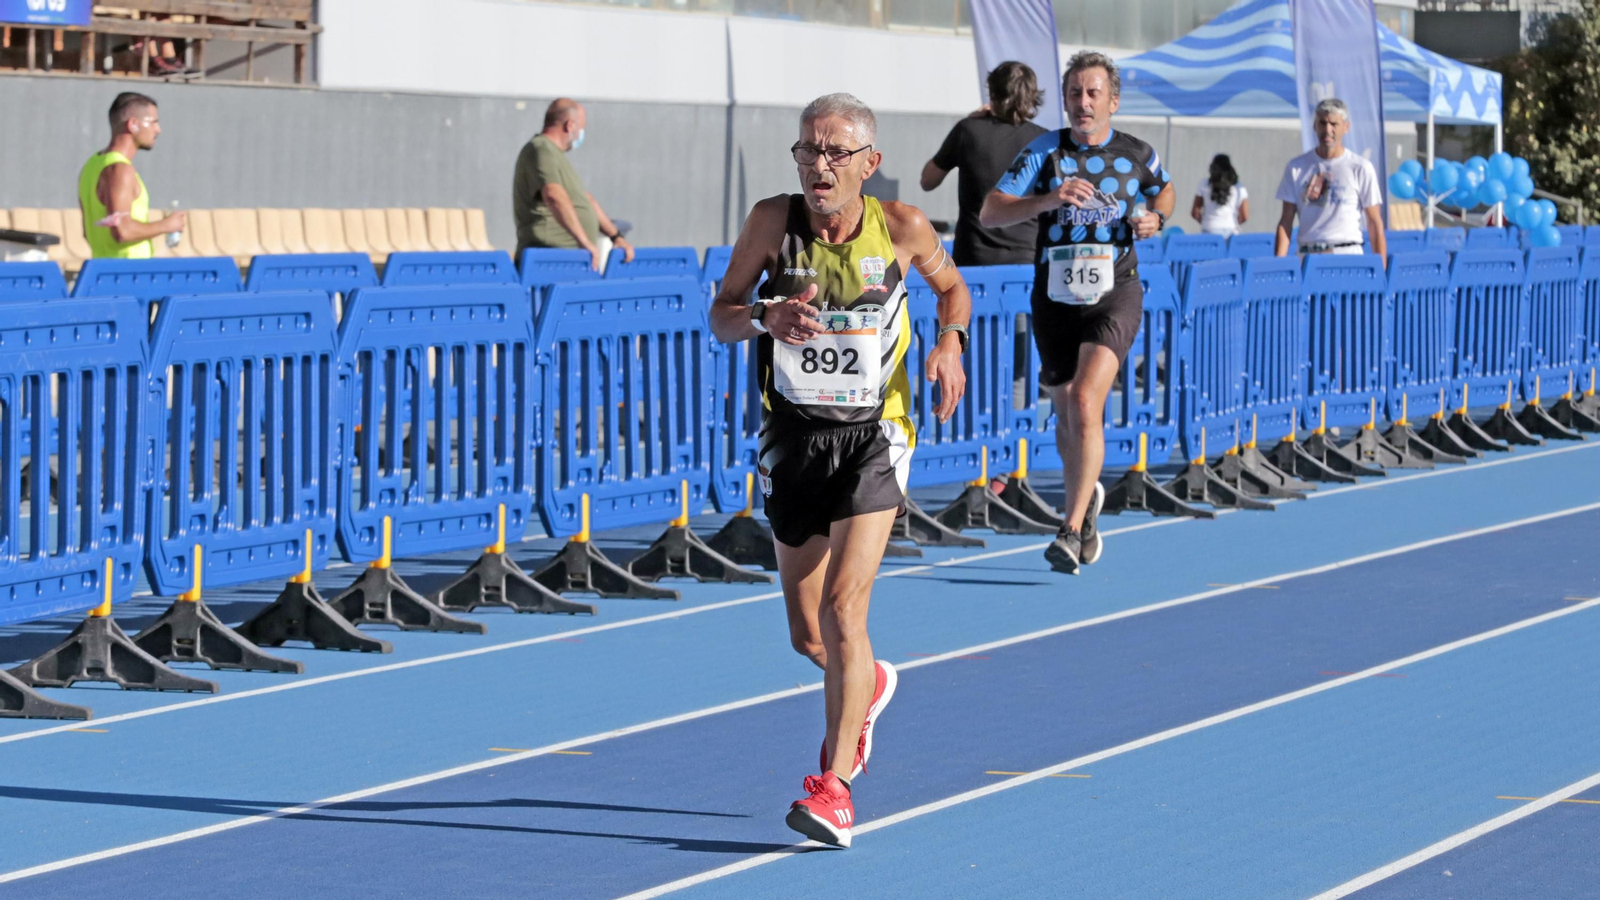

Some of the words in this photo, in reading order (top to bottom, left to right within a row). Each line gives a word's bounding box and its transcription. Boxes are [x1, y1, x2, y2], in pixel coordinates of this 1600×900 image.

[1062, 206, 1120, 225] PIRATA
[1063, 267, 1100, 285] 315
[800, 347, 859, 375] 892
